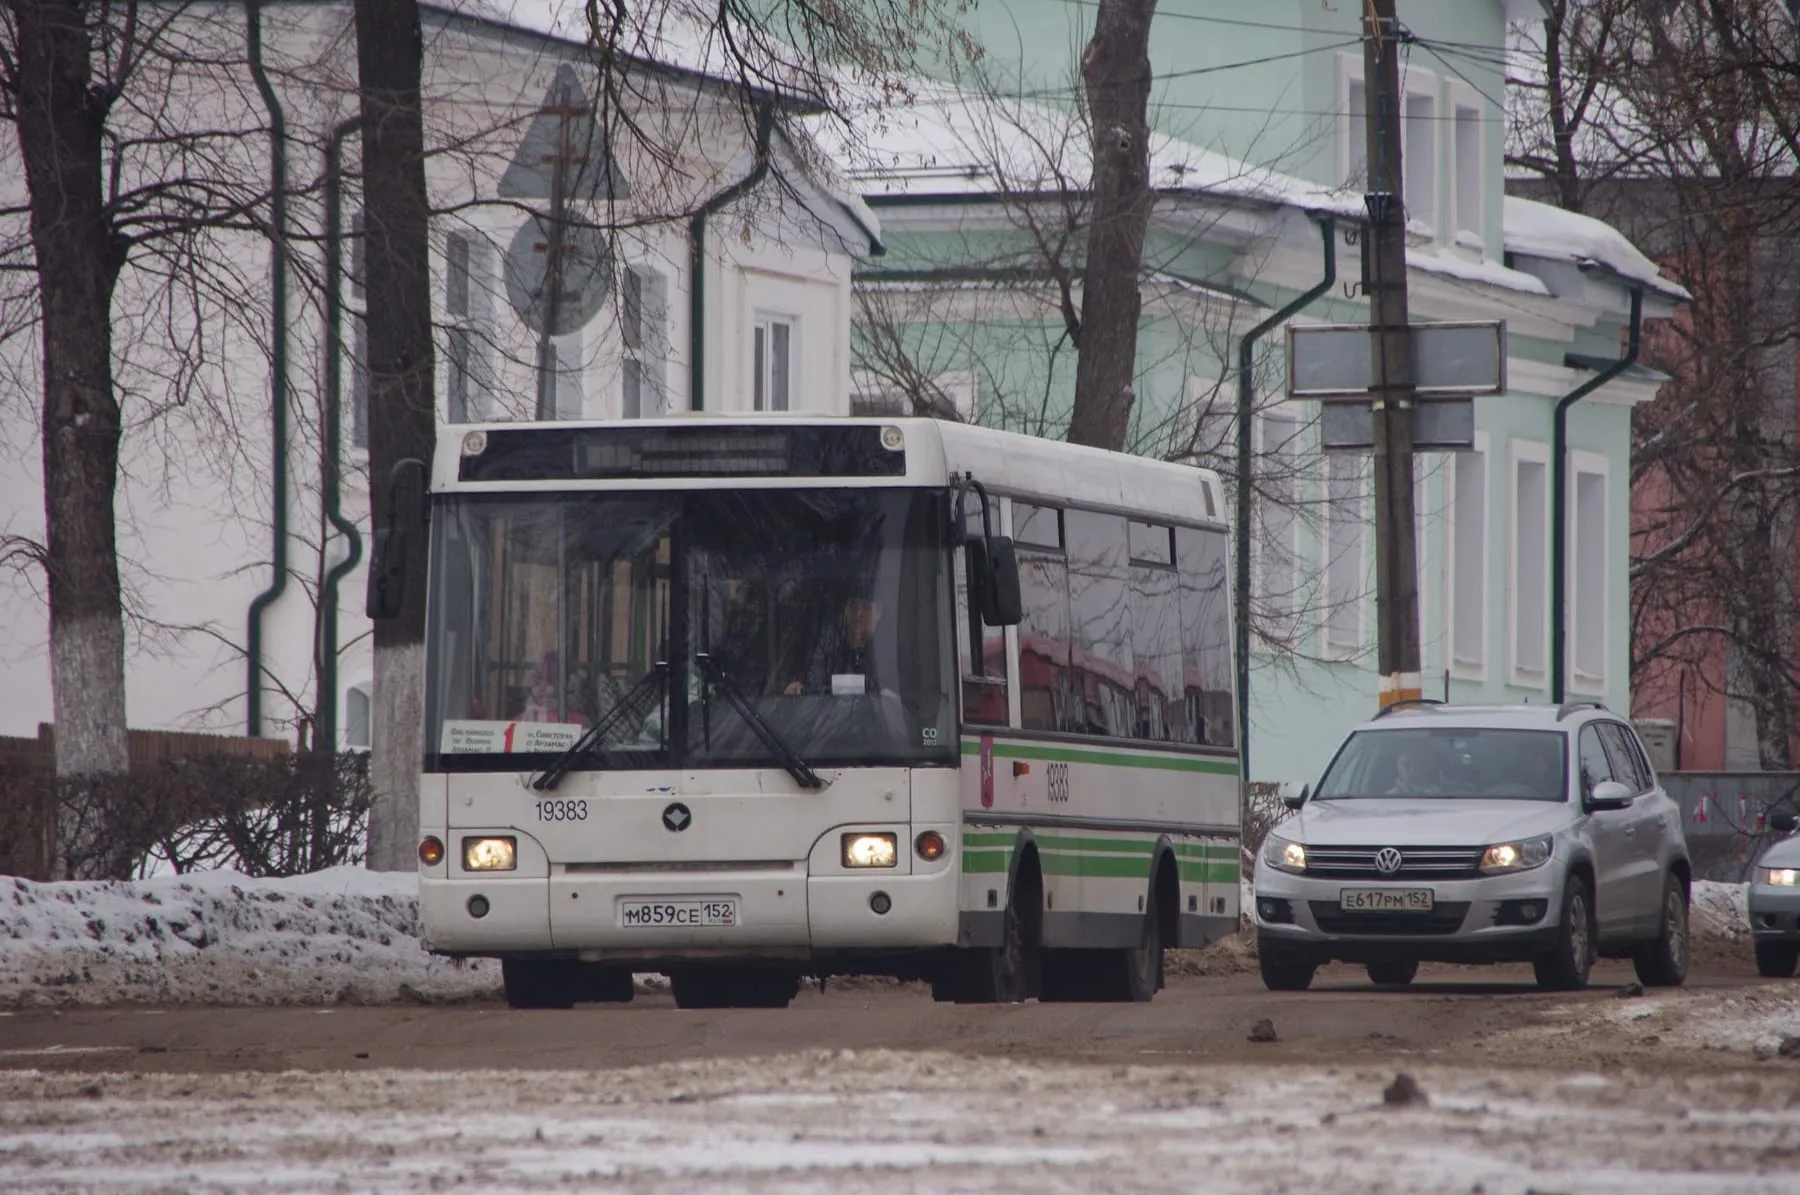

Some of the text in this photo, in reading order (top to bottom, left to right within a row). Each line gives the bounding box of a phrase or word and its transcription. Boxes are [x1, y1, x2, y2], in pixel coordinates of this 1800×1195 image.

[503, 723, 516, 754] 1
[1046, 762, 1069, 803] 19383
[535, 800, 588, 821] 19383
[1346, 891, 1428, 908] Е617РМ 152
[628, 903, 731, 924] М859СЕ 152
